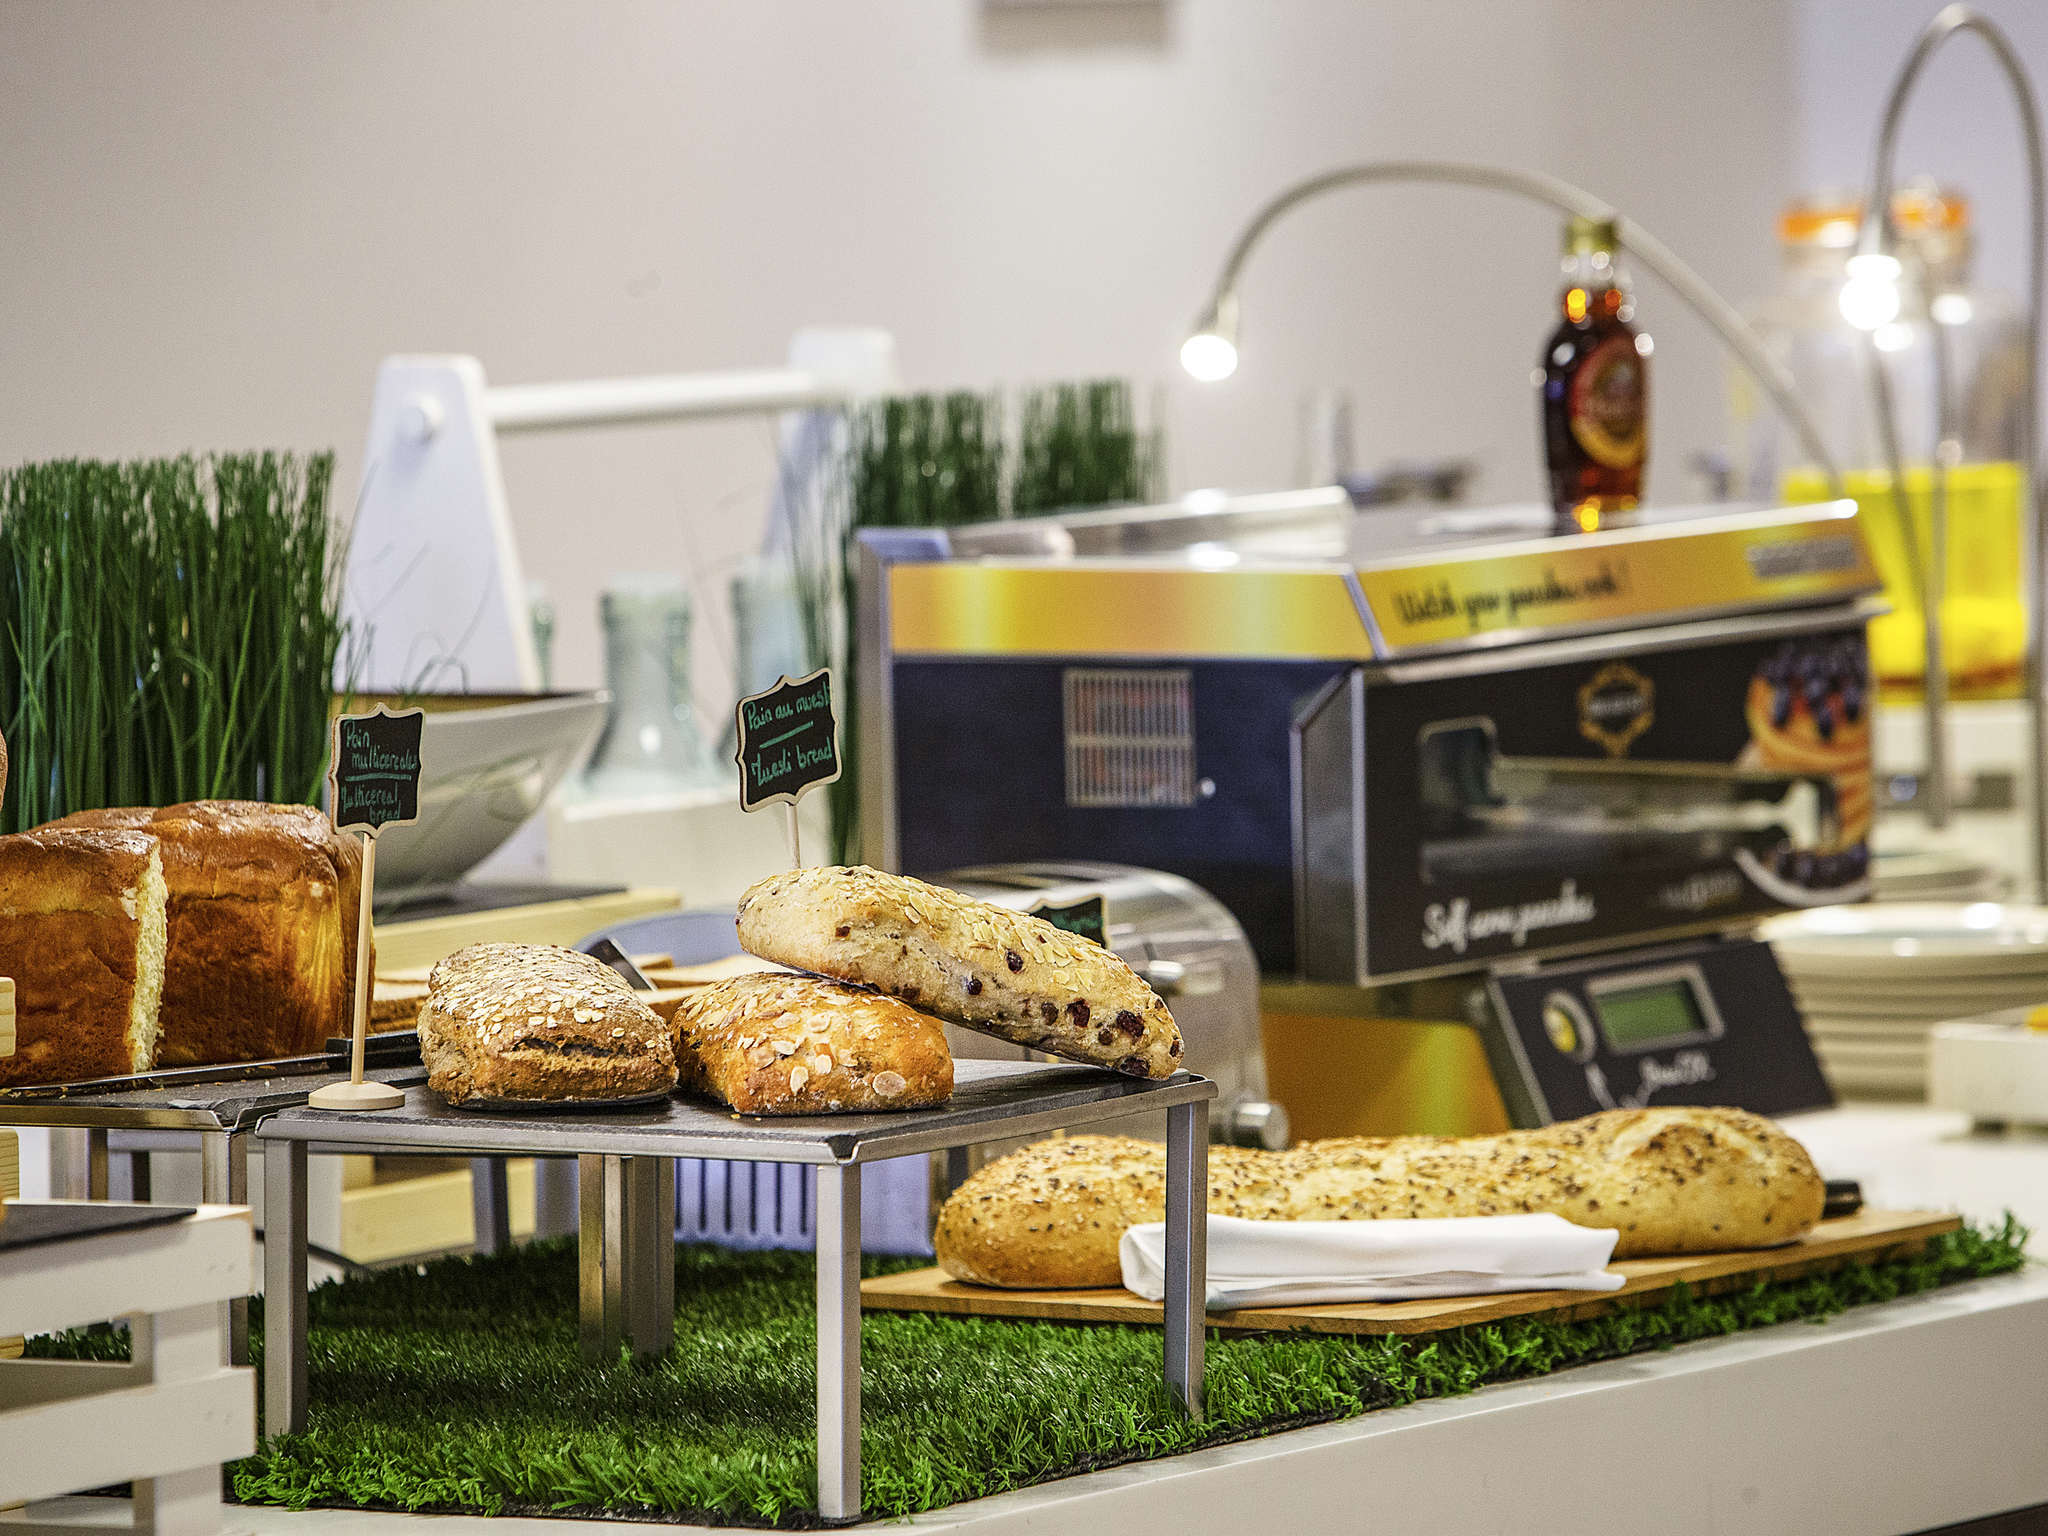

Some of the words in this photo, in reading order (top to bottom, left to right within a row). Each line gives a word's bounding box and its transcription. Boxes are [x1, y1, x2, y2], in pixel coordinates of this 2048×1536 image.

[743, 701, 773, 731] Pain
[775, 703, 794, 719] au
[343, 718, 369, 748] Pain
[796, 736, 833, 768] bread
[369, 800, 400, 824] bread
